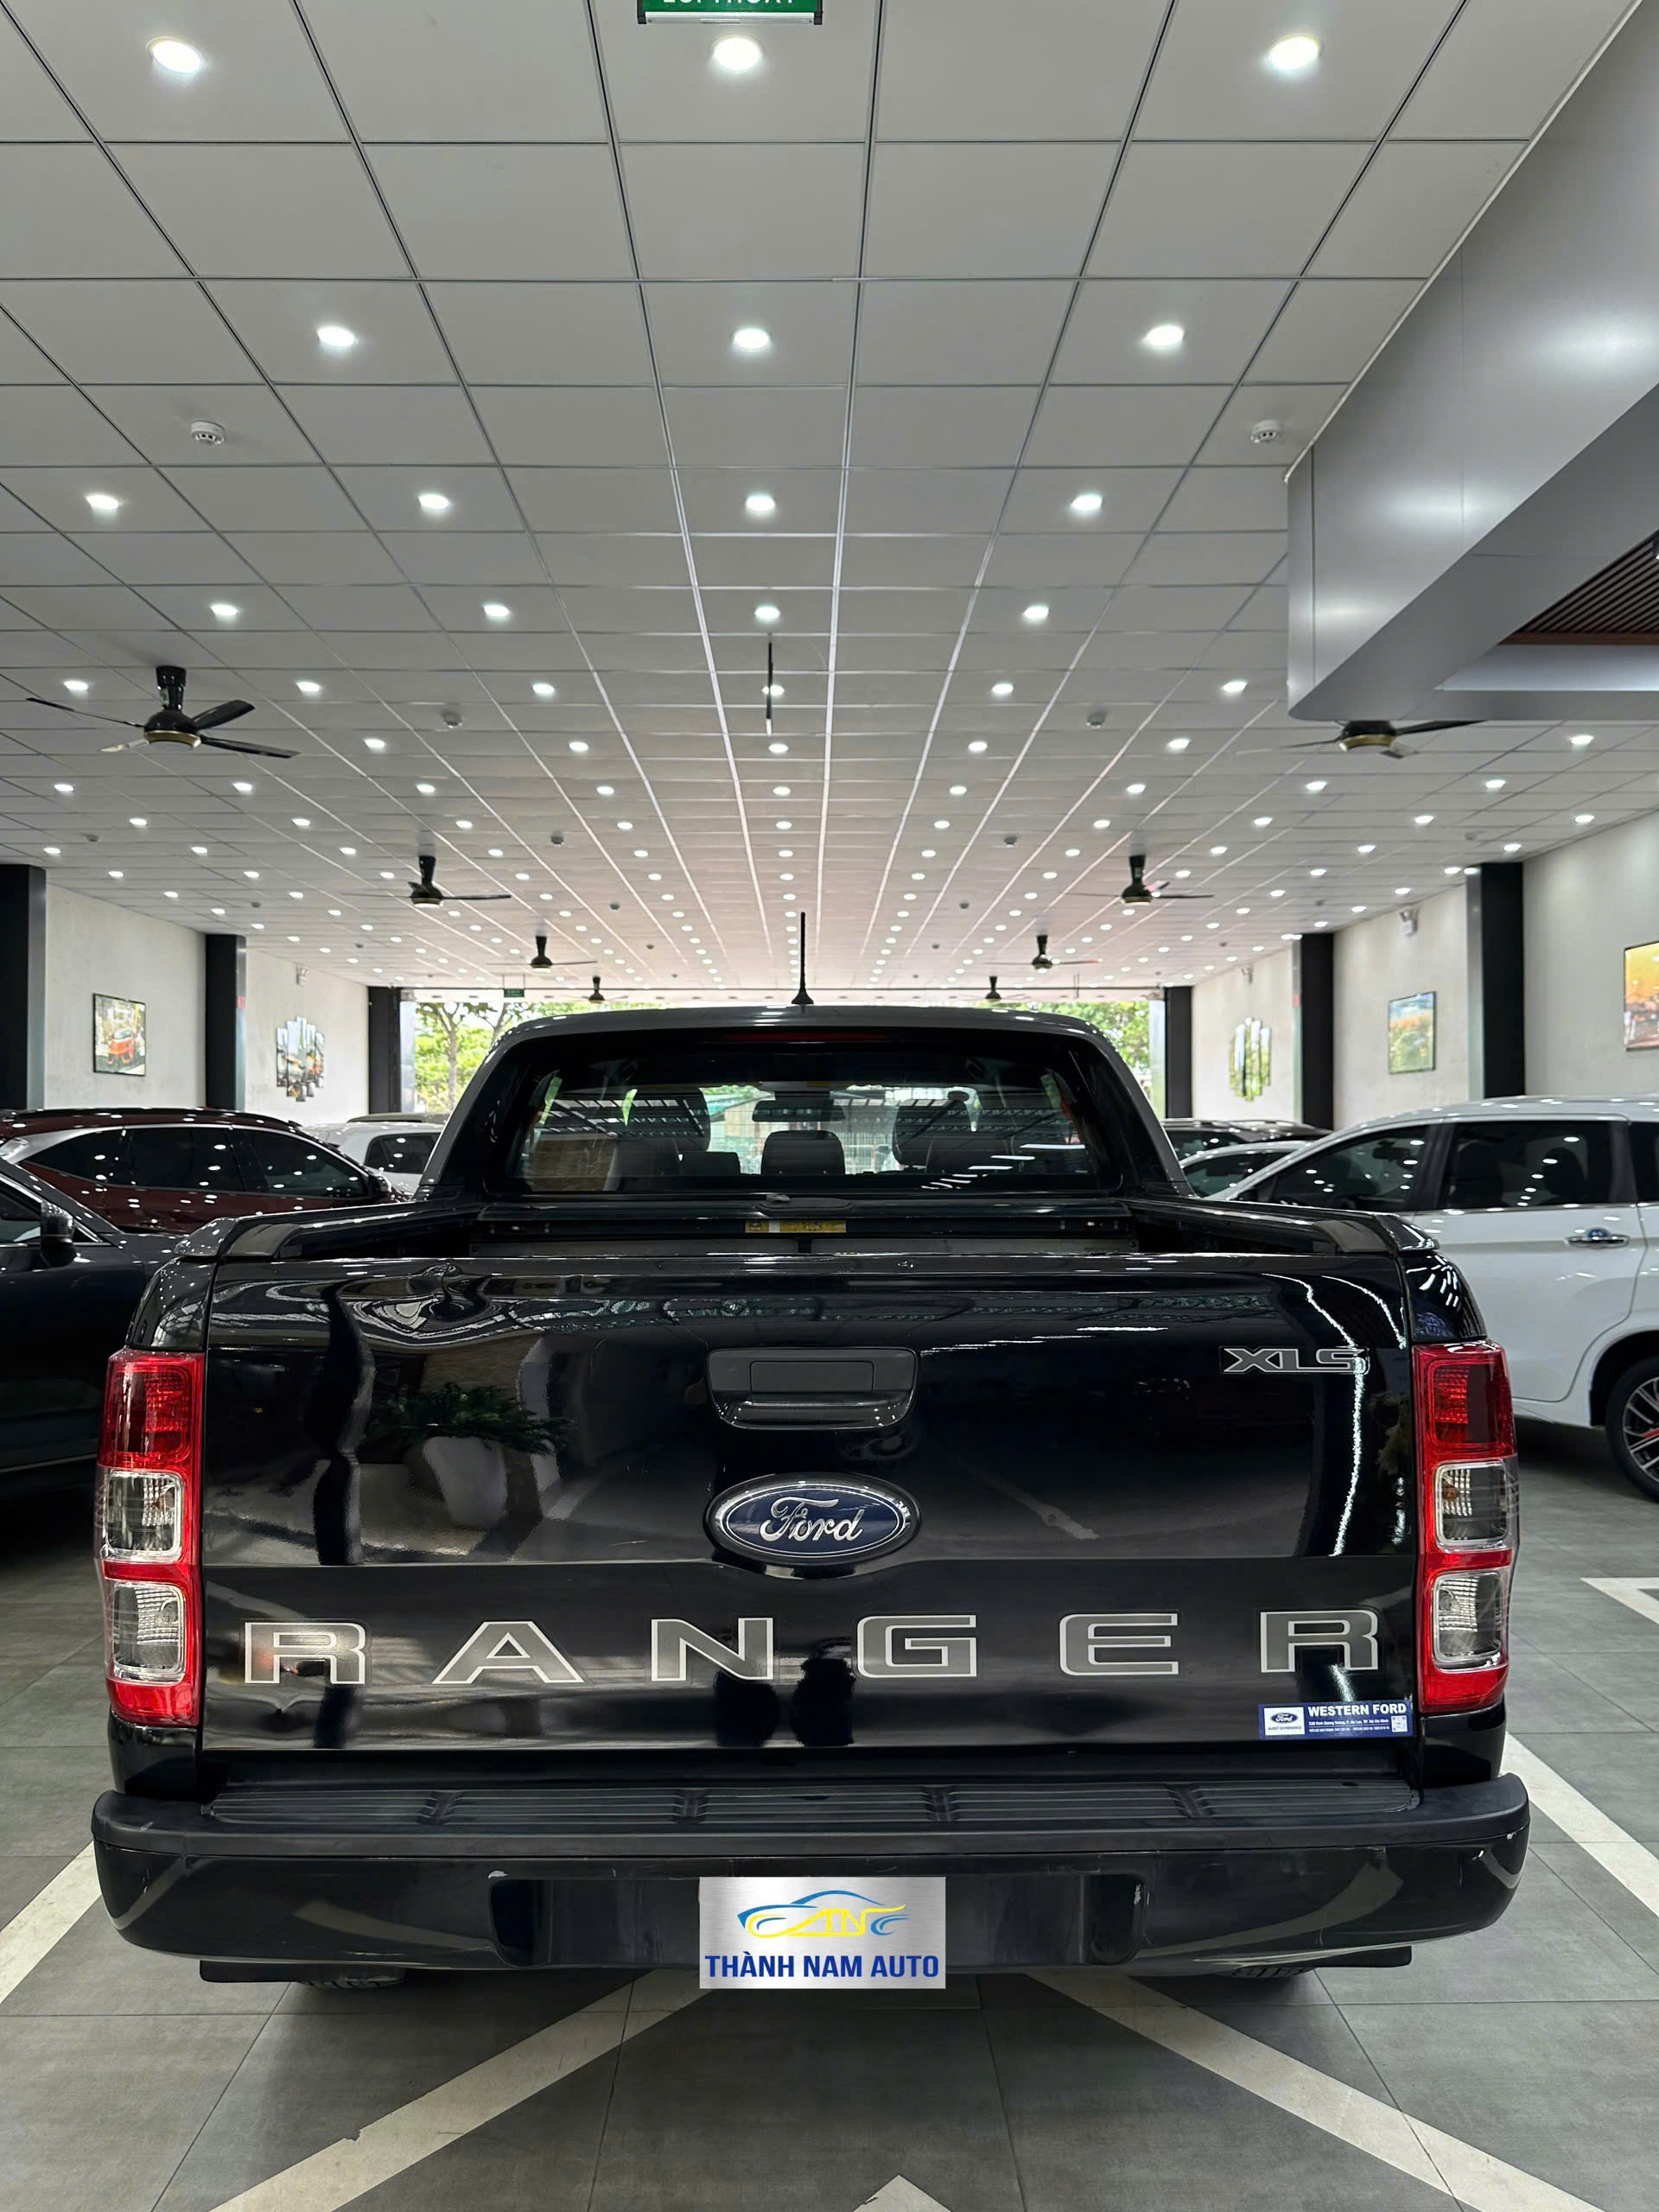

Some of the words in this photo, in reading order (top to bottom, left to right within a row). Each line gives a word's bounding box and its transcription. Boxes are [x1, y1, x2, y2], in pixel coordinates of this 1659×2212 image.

[1224, 1348, 1367, 1373] XLS
[760, 1497, 865, 1541] Ford
[244, 1611, 1380, 1685] RANGER
[1307, 1705, 1370, 1717] WESTERN
[1372, 1703, 1407, 1714] FORD
